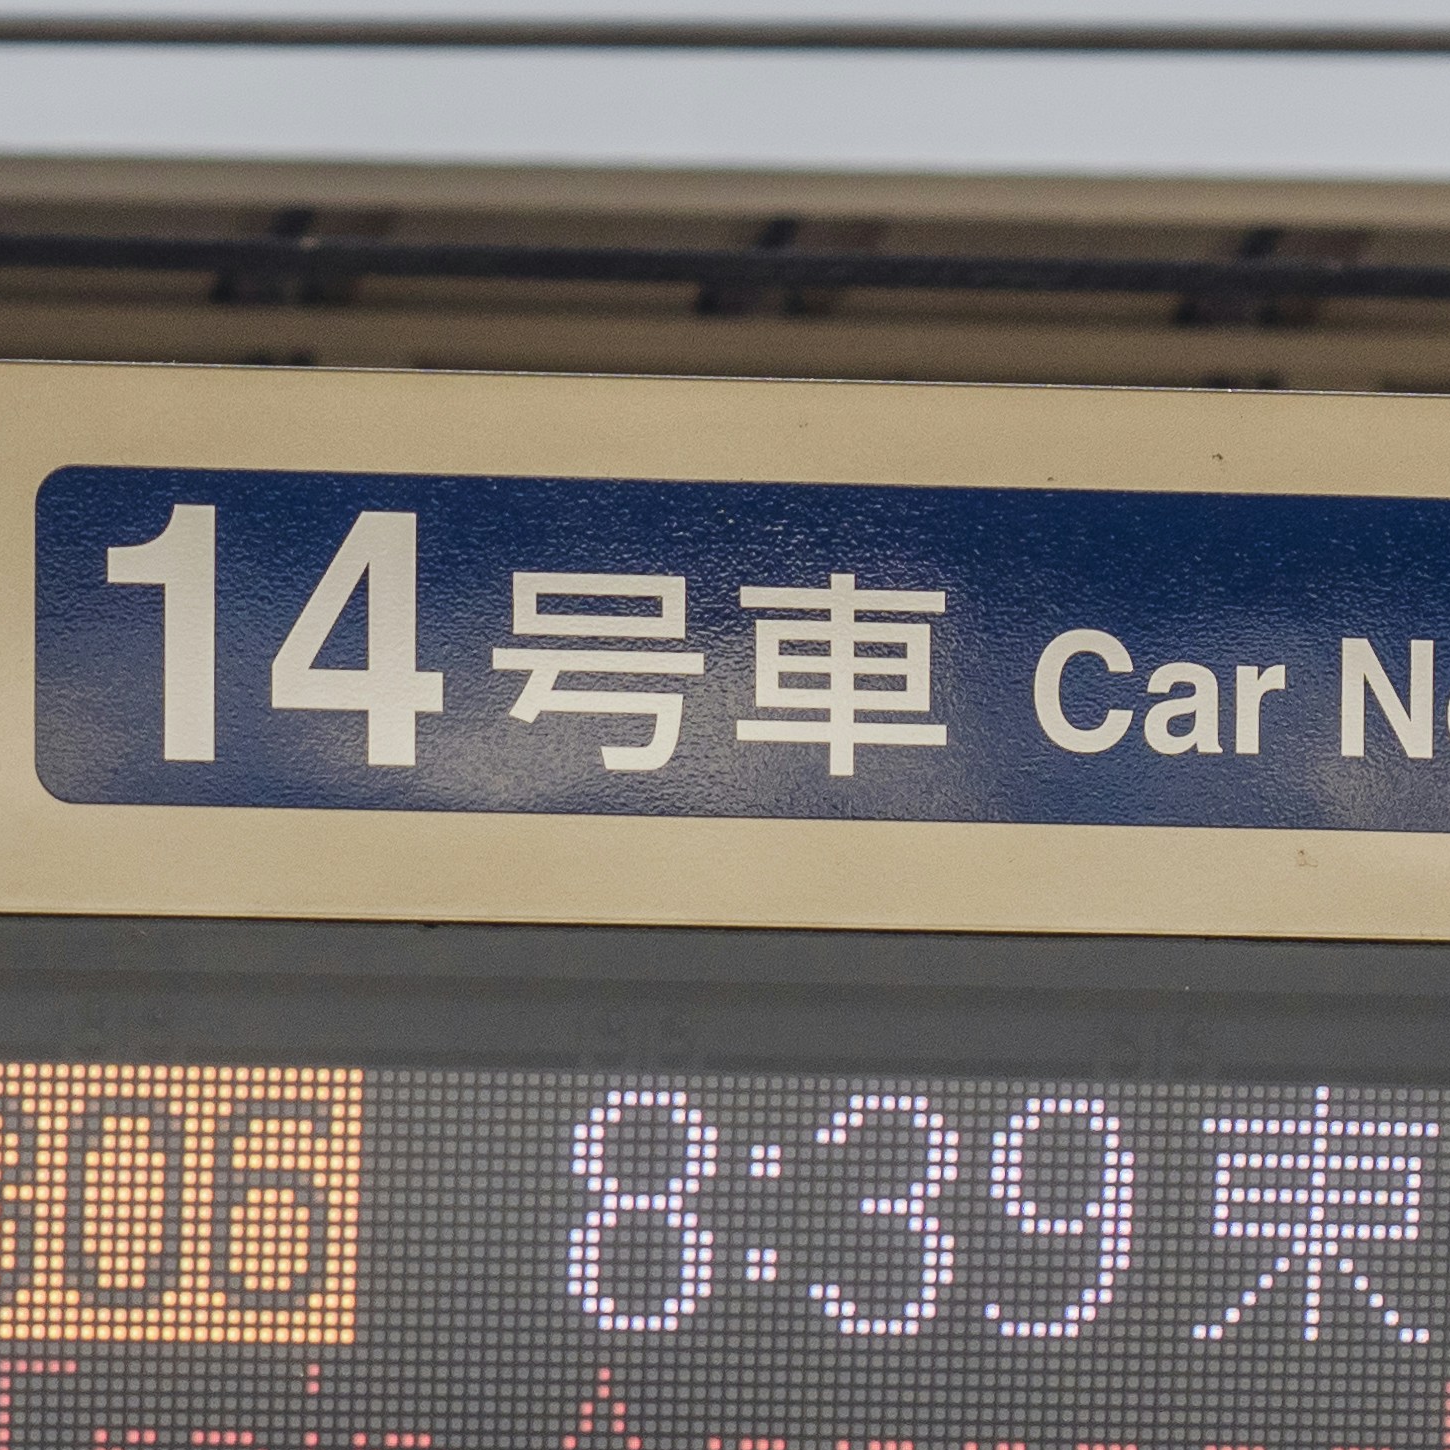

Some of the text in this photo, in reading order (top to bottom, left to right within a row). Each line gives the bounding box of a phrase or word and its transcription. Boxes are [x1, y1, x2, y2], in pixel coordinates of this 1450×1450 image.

[106, 502, 950, 778] 14号車
[1033, 629, 1286, 756] Car
[566, 1089, 1136, 1338] 8:39
